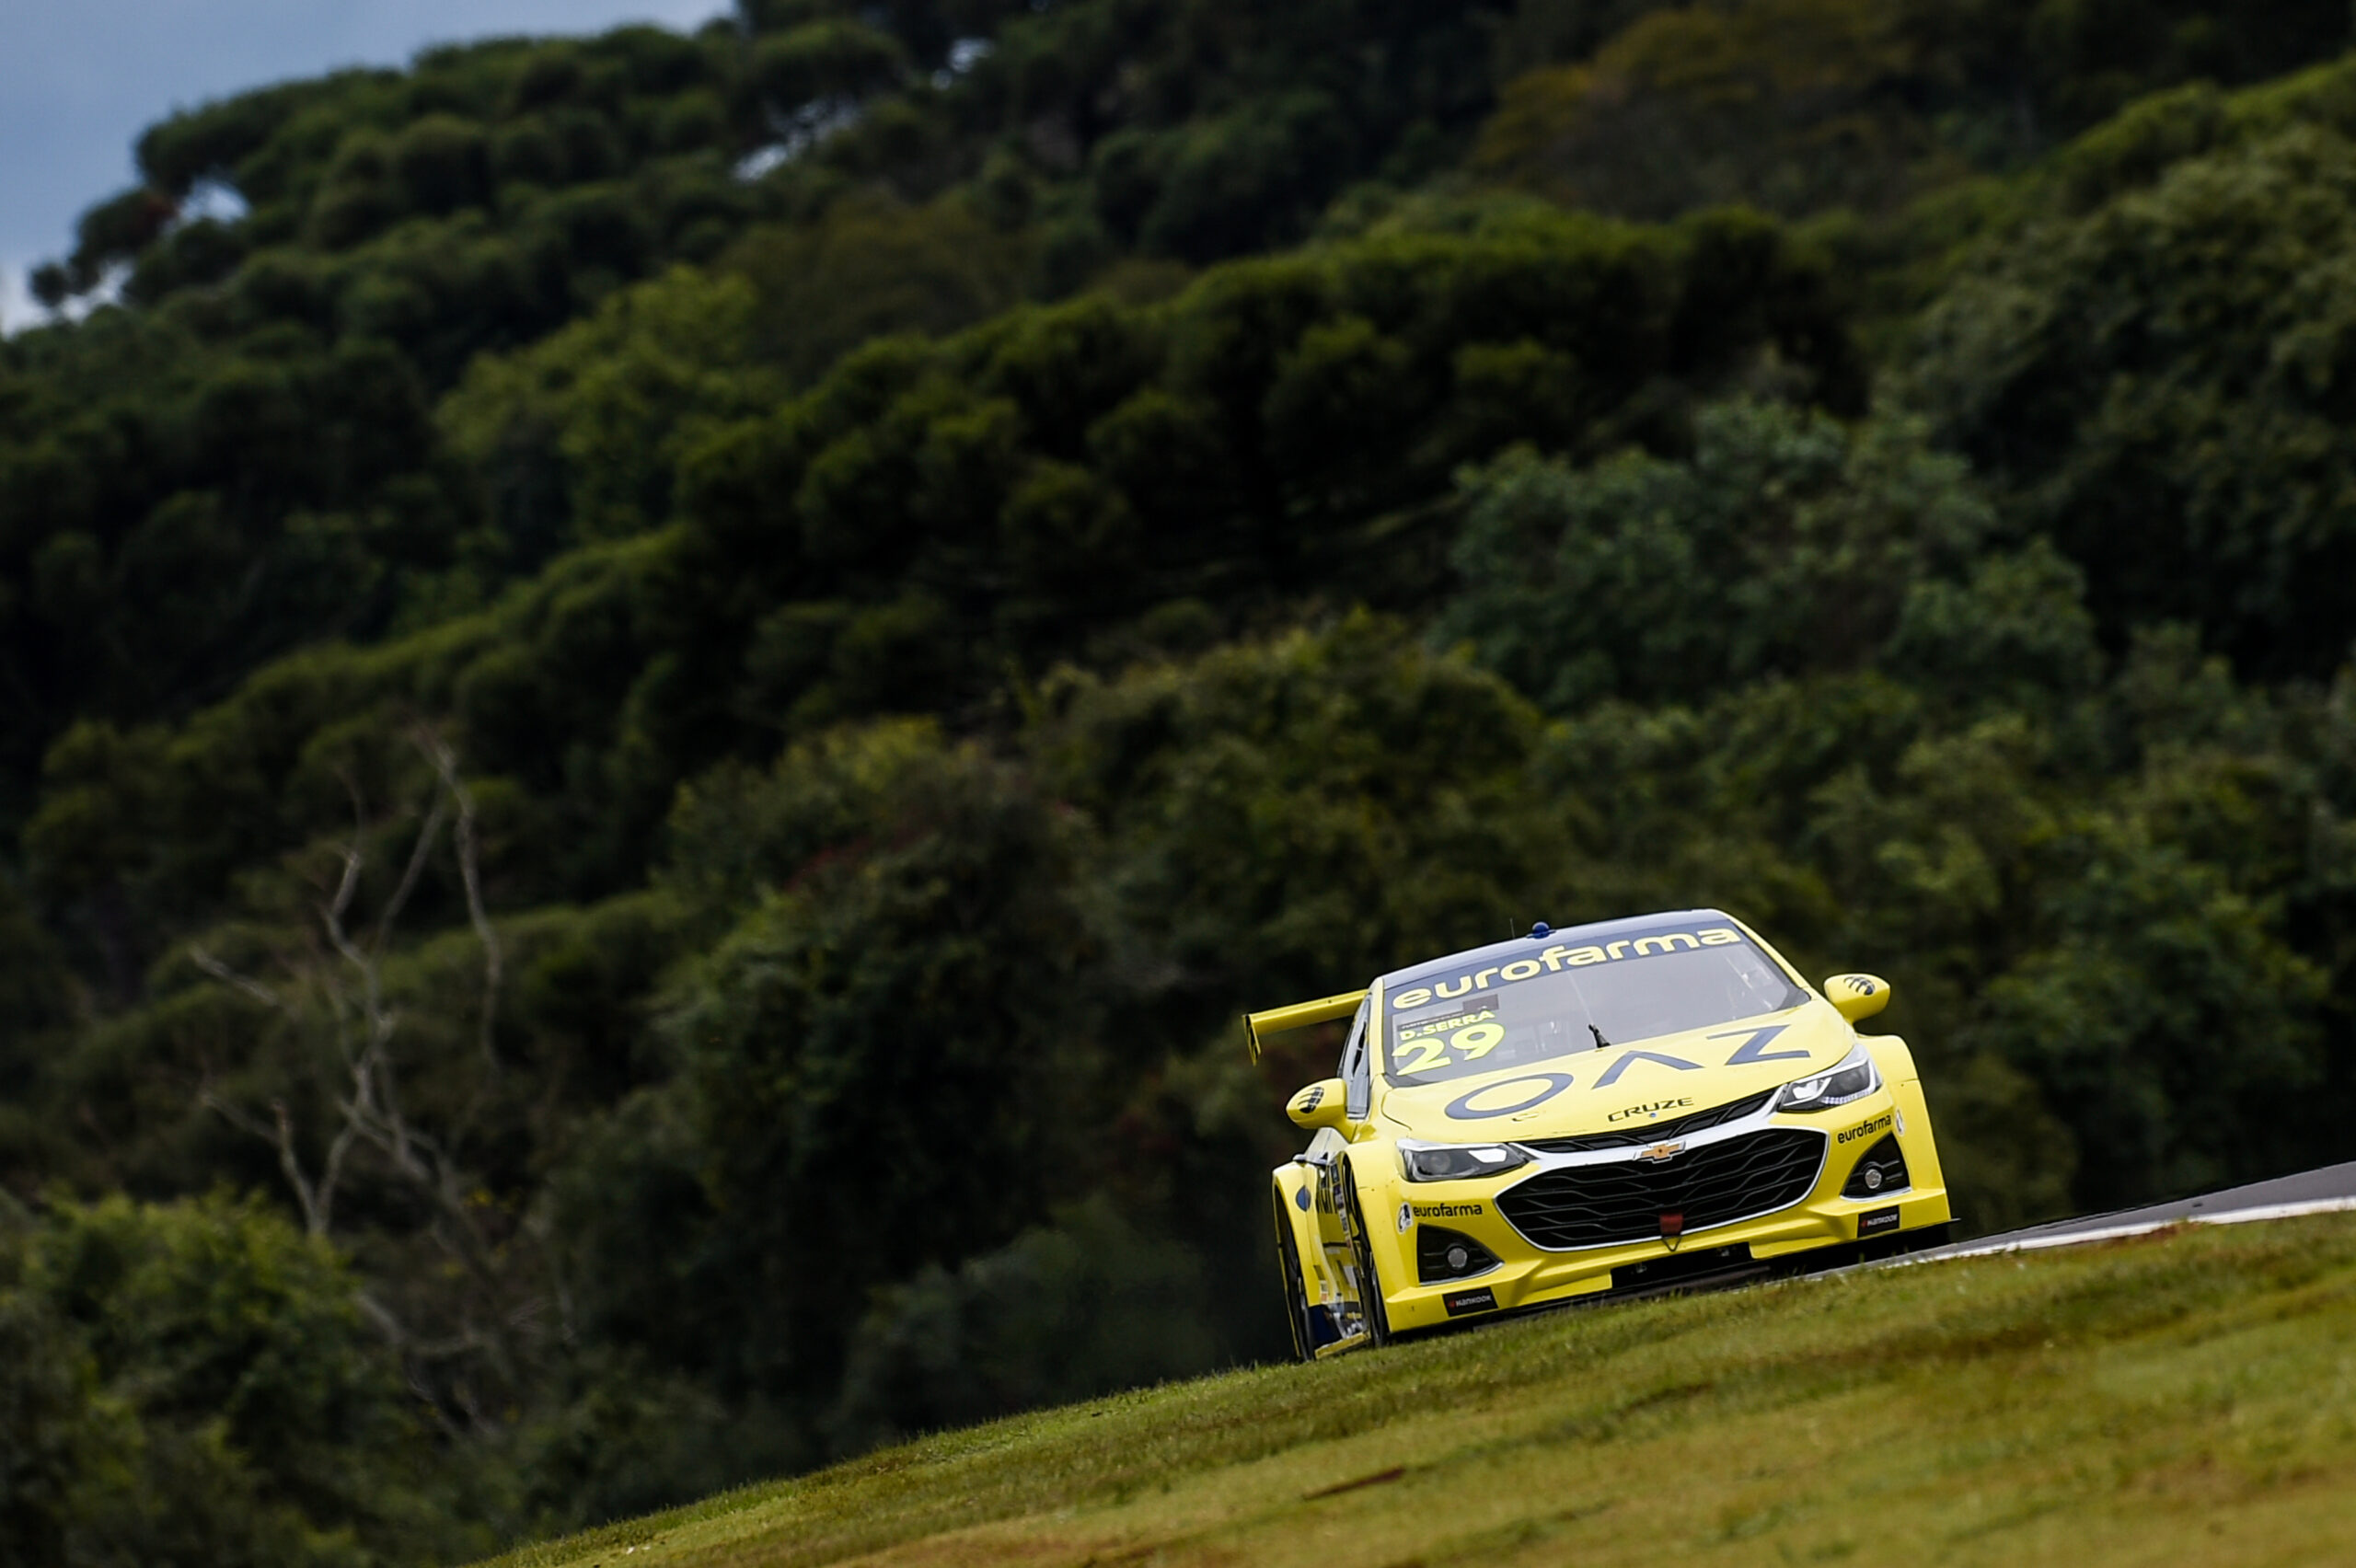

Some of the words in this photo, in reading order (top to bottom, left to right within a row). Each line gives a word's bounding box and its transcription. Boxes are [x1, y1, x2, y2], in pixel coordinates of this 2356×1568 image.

[1392, 928, 1741, 1009] eurofarma
[1399, 1010, 1496, 1041] D.SERRA
[1392, 1023, 1505, 1076] 29
[1608, 1097, 1693, 1122] CRUZE
[1838, 1114, 1891, 1144] eurofarma
[1413, 1203, 1483, 1216] eurofarma
